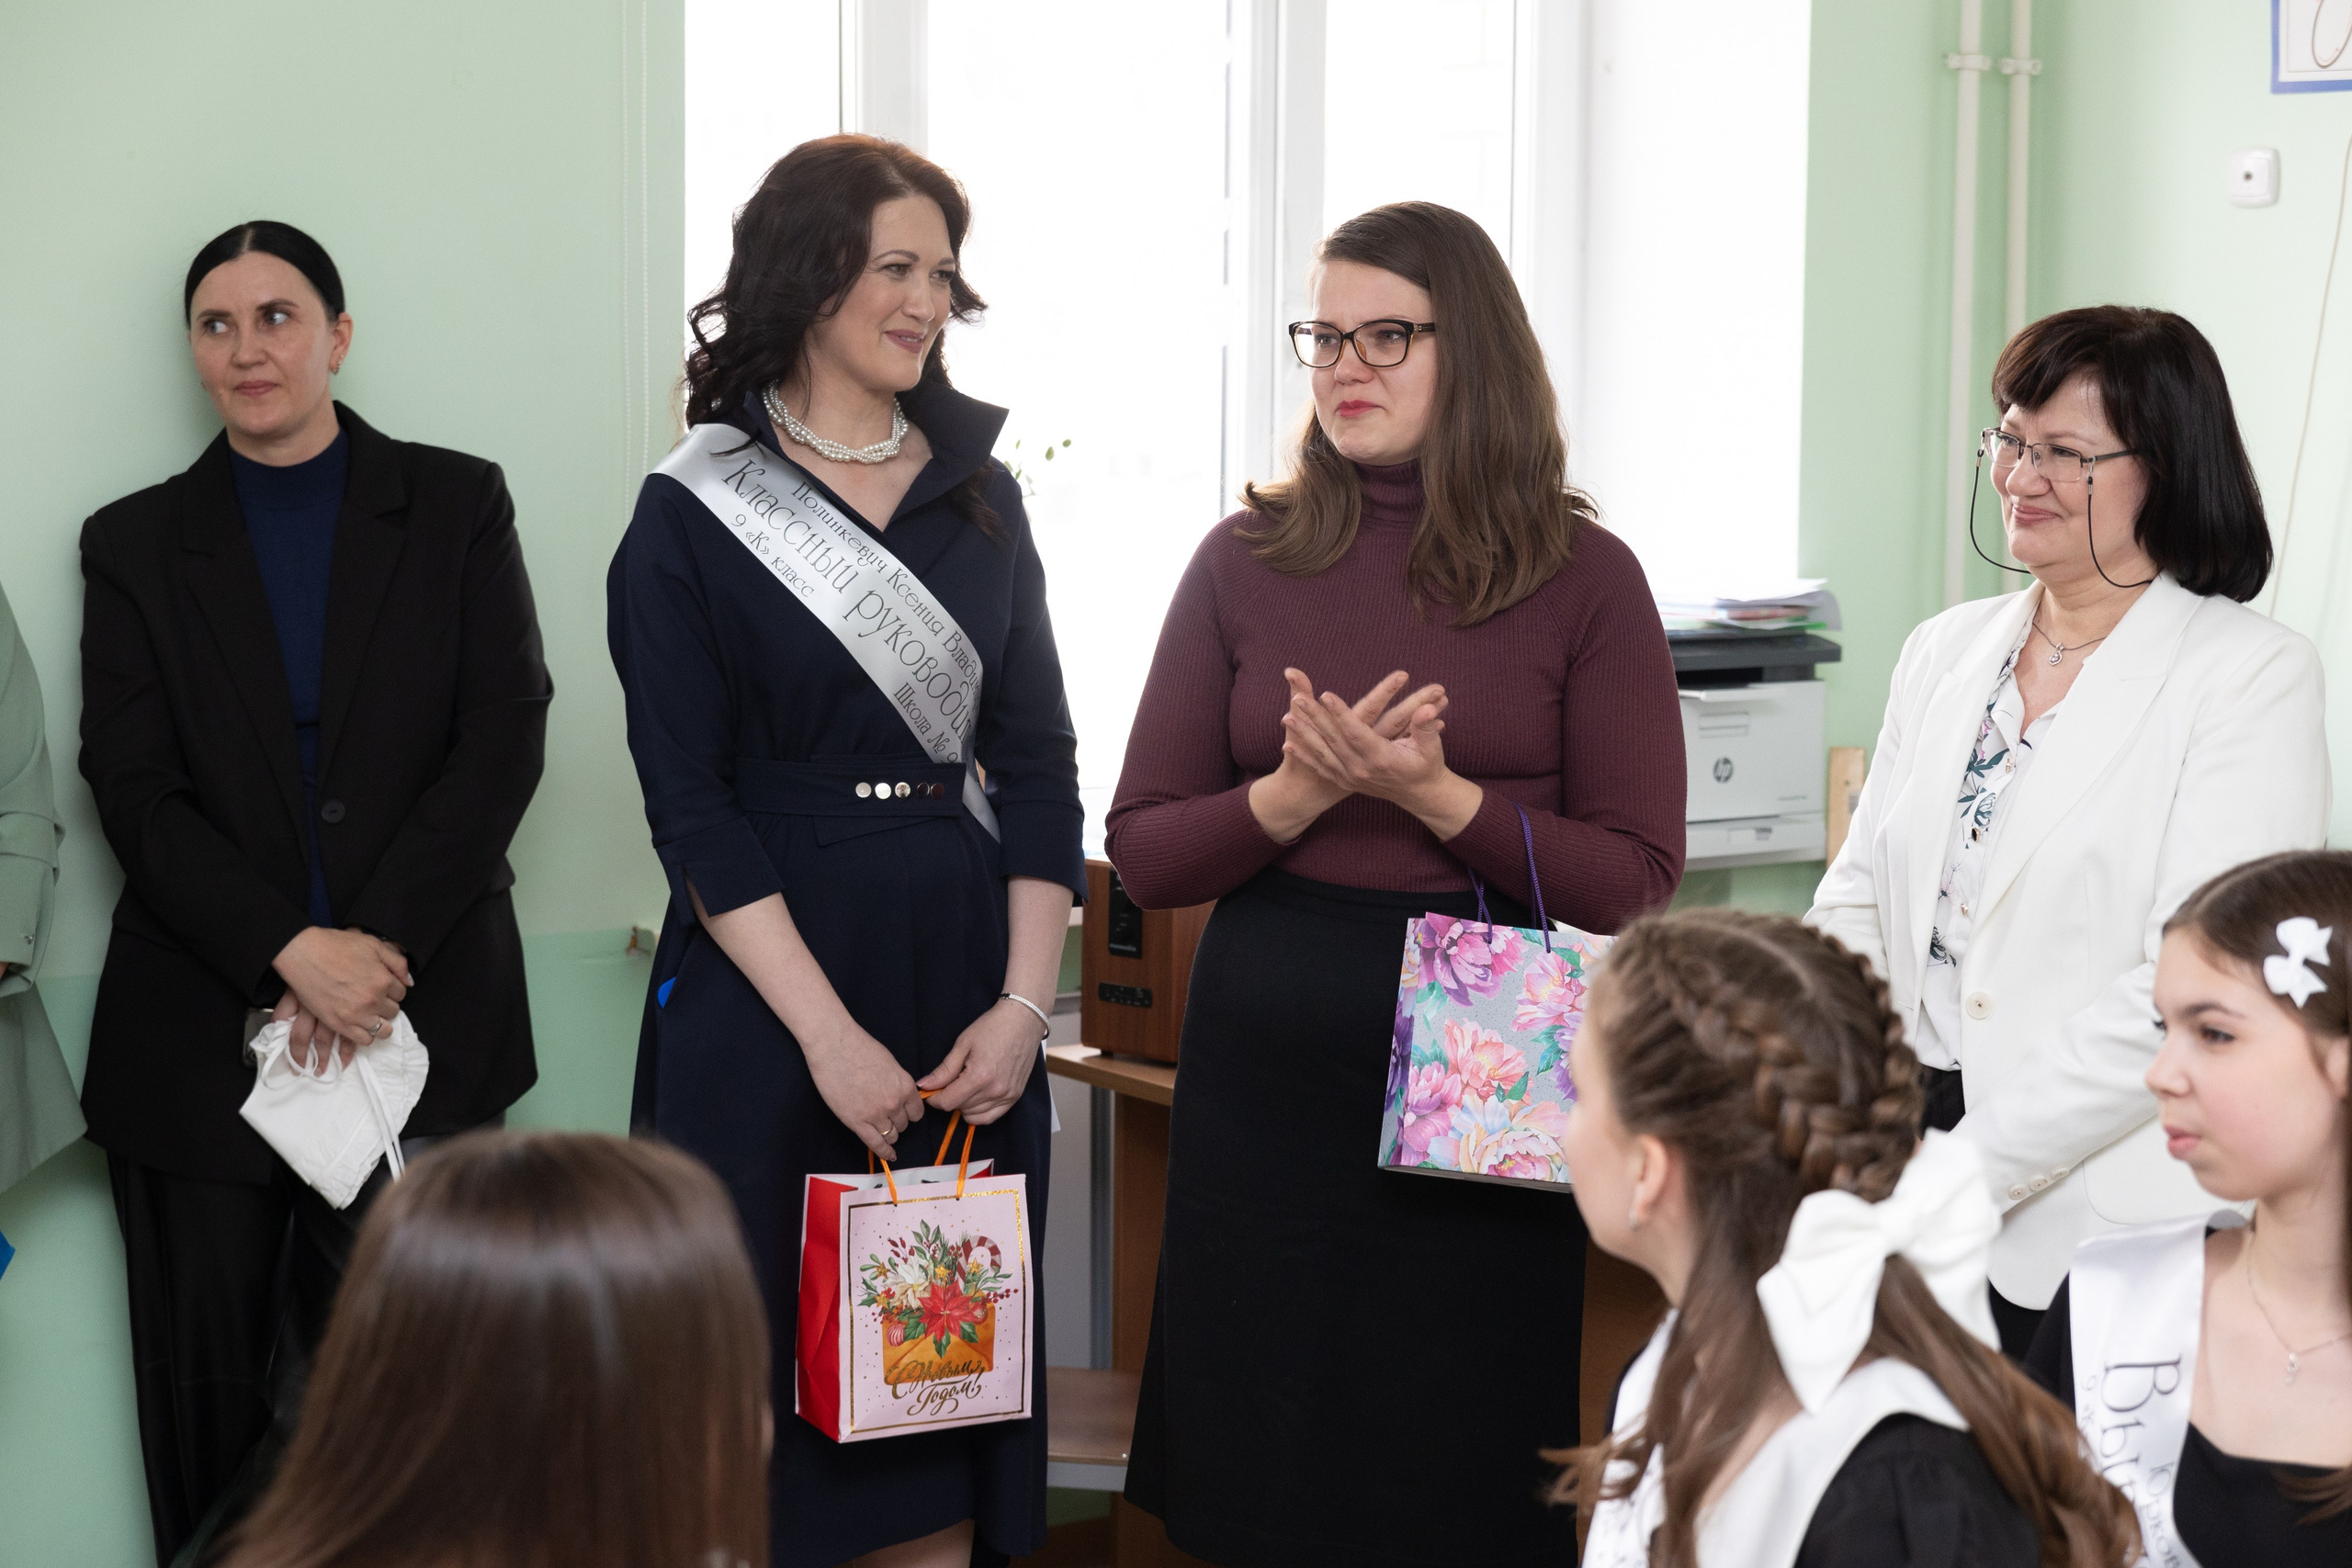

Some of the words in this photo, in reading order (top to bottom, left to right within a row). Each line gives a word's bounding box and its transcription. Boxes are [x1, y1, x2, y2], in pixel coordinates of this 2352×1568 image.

[721, 458, 868, 594] Классный
[731, 513, 747, 527] 9
[745, 531, 770, 555] «К»
[771, 557, 815, 598] класс
[791, 481, 888, 574] Полинкевич
[886, 567, 945, 637] Ксения
[893, 682, 932, 736] Школа
[927, 731, 950, 754] №
[1713, 757, 1734, 784] hp
